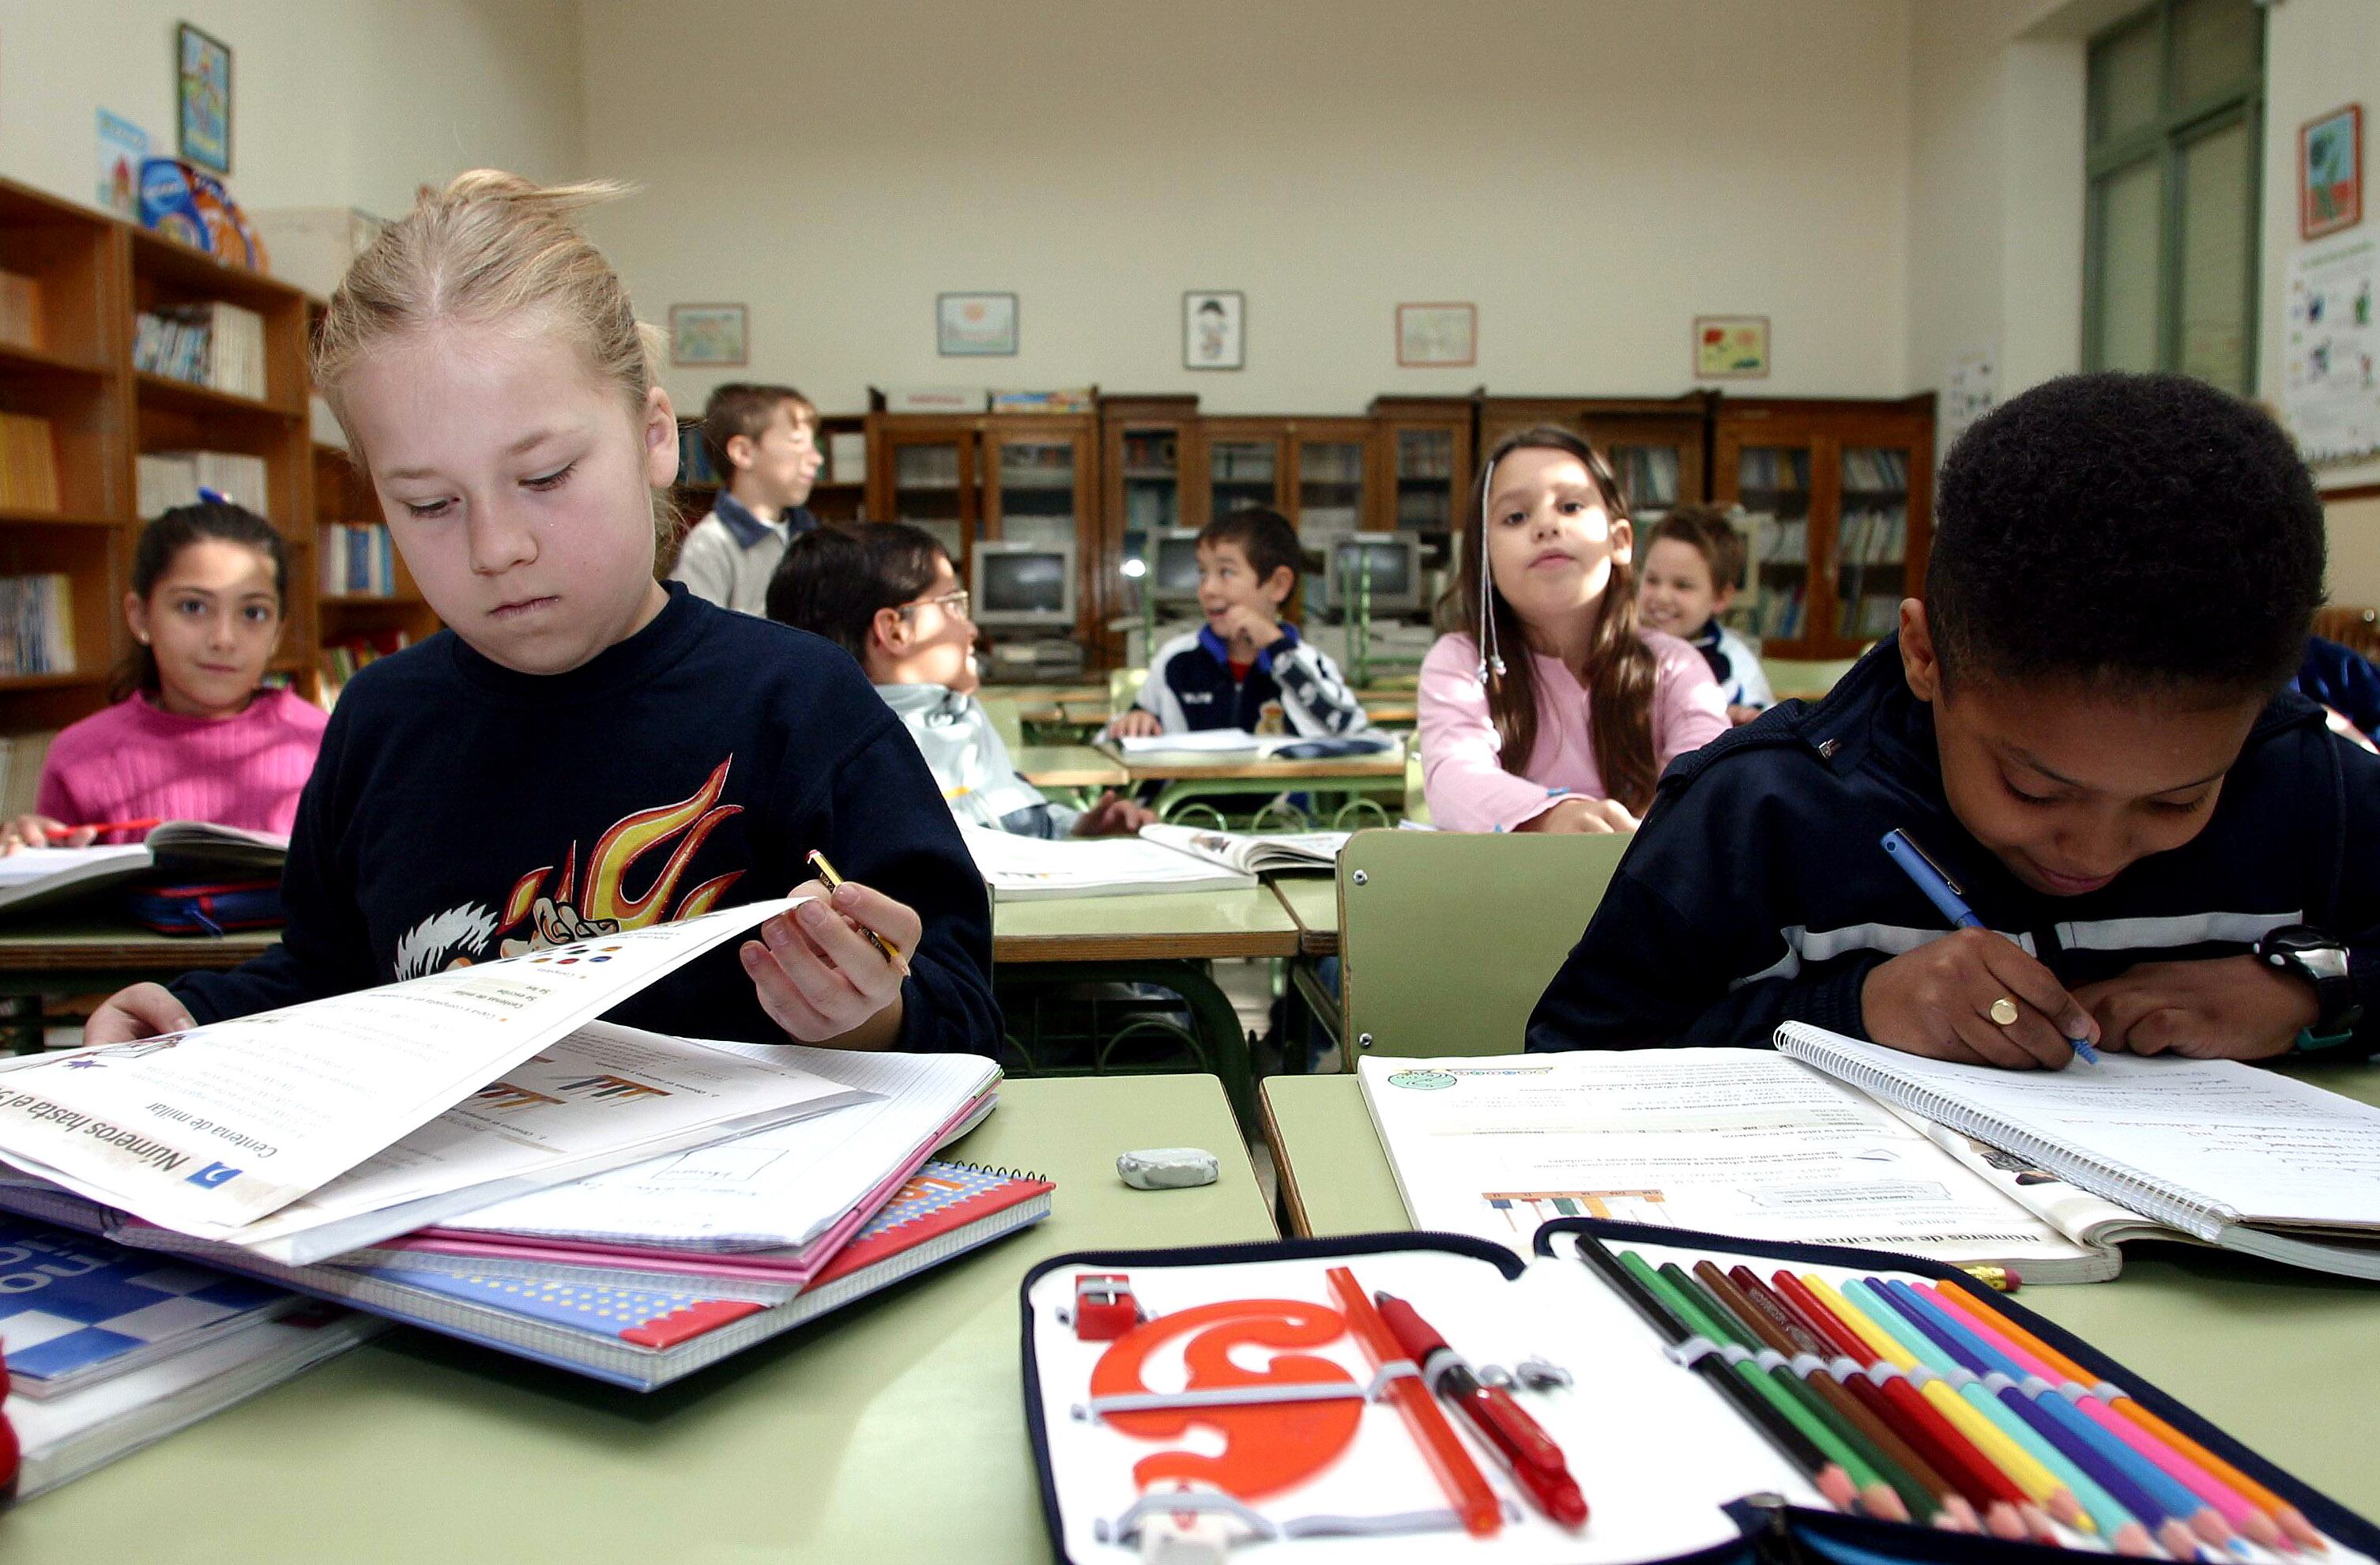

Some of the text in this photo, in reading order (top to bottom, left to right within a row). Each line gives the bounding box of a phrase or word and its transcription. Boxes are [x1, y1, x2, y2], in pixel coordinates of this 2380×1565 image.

[0, 1095, 35, 1113] el
[28, 1099, 92, 1134] hasta
[144, 1101, 279, 1160] Centena de millar
[82, 1121, 191, 1174] Números
[1874, 1235, 1915, 1246] seis
[1918, 1235, 1944, 1244] de
[1948, 1234, 2041, 1243] Números
